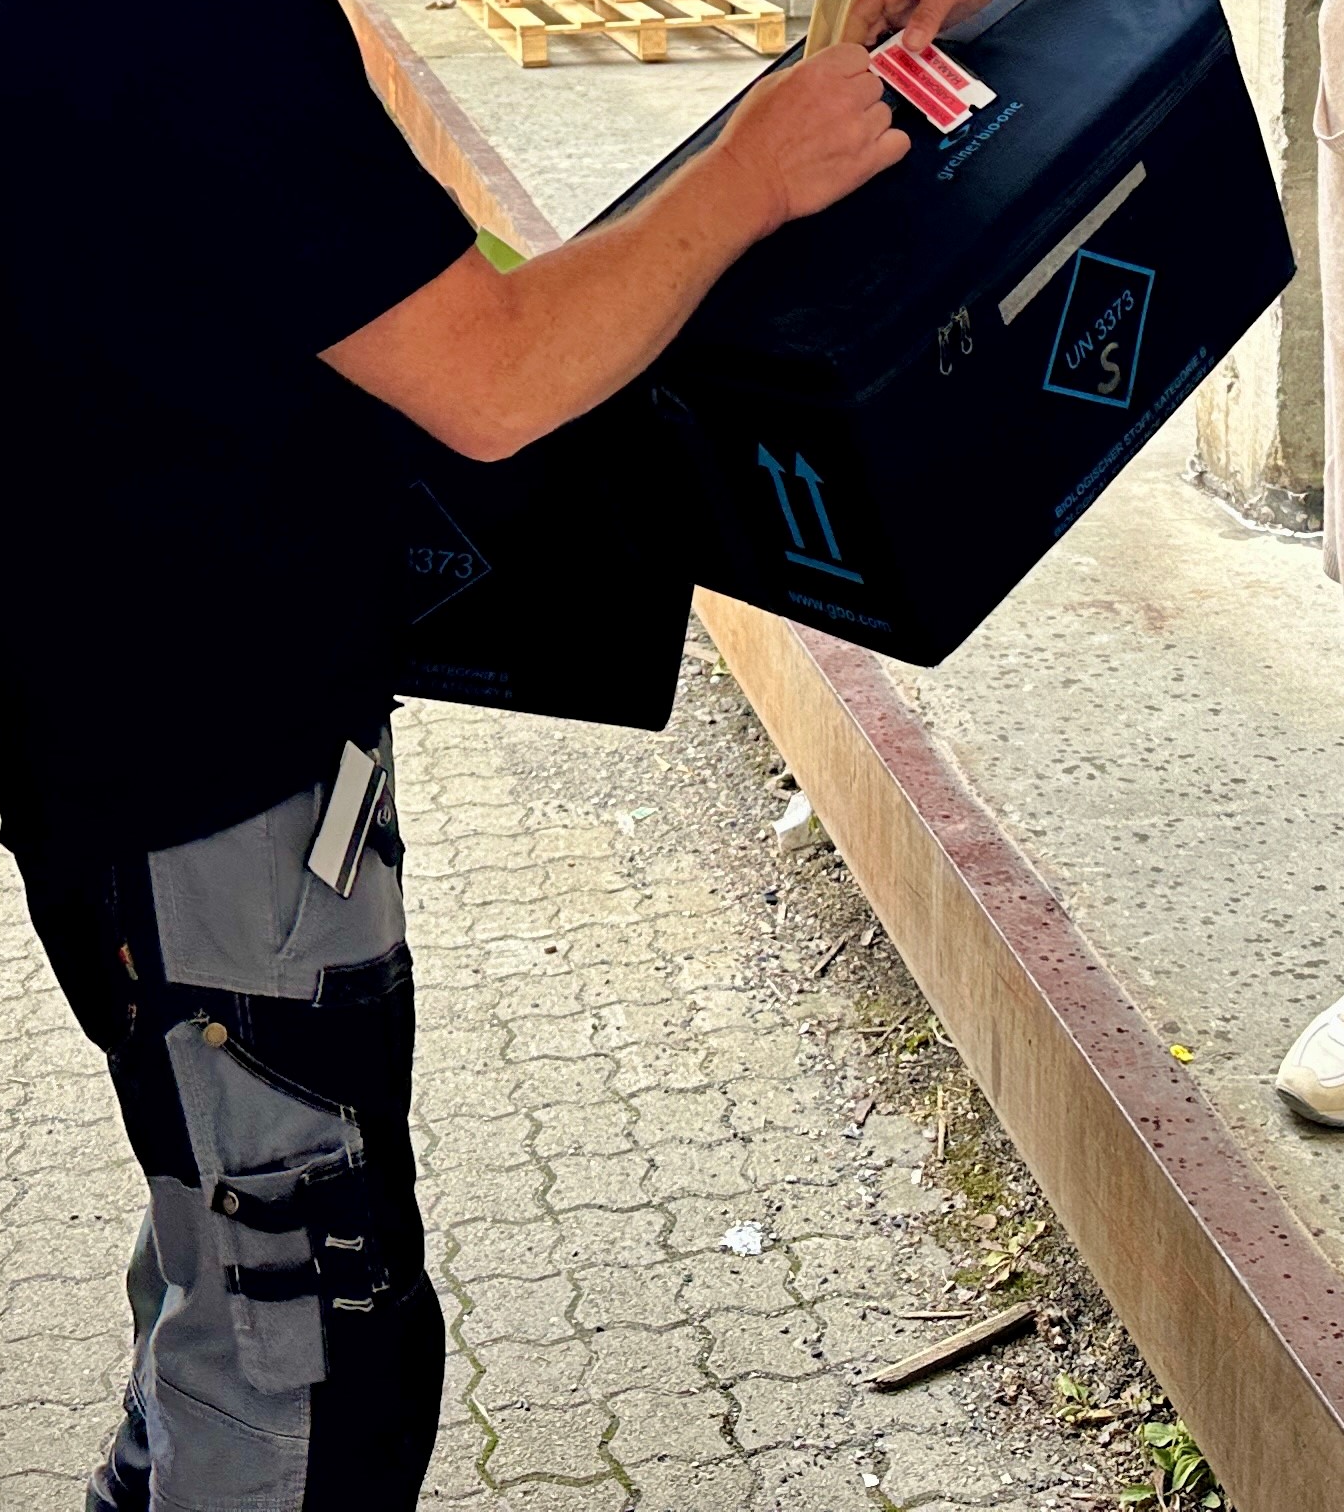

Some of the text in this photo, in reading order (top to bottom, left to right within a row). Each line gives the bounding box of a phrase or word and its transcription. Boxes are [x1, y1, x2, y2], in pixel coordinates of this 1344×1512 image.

[937, 101, 1023, 181] greiner bio-one
[1066, 289, 1135, 370] UN 3373
[1097, 342, 1121, 394] S
[1055, 441, 1124, 518] BIOLOGISCHER
